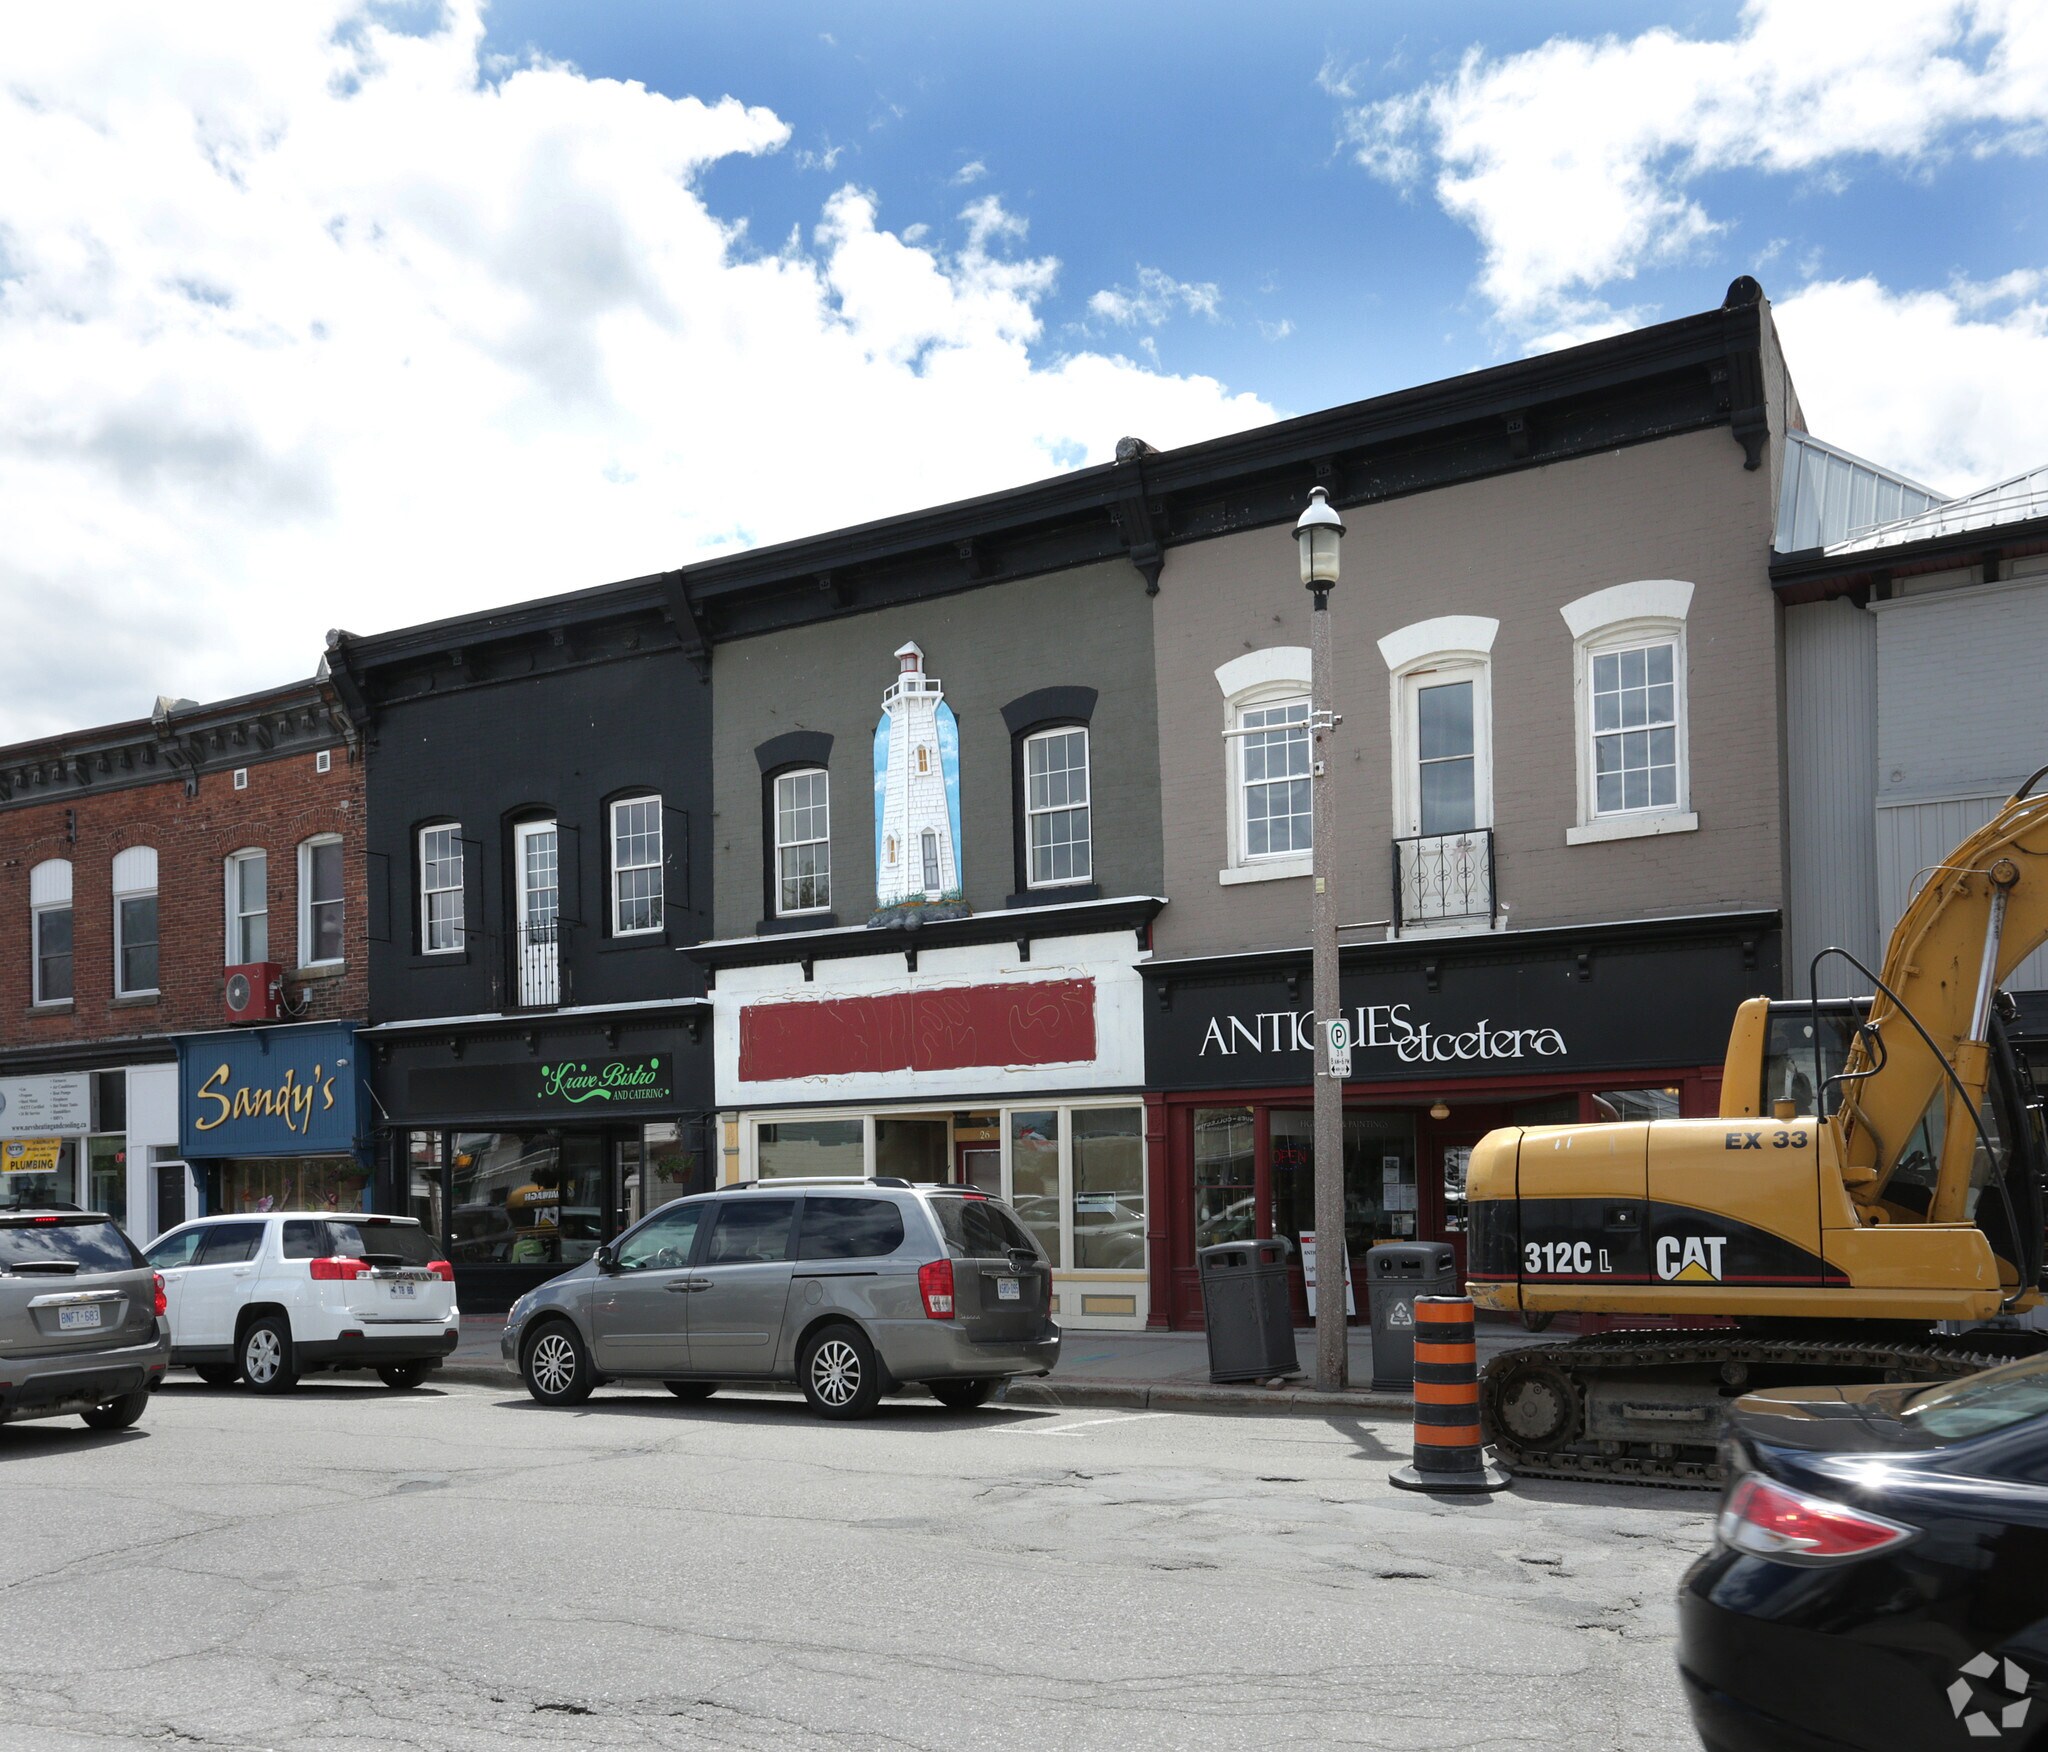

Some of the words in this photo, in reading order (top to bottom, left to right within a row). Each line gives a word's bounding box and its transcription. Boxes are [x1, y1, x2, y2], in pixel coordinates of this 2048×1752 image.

[1335, 1029, 1343, 1043] P
[1397, 1018, 1567, 1062] etcetera
[546, 1062, 600, 1098] Krave
[598, 1062, 656, 1087] Bistro
[195, 1063, 336, 1135] Sandy's
[613, 1089, 628, 1101] AND
[628, 1088, 664, 1100] CATERING
[980, 1130, 990, 1140] 26
[1725, 1132, 1762, 1150] EX
[1772, 1130, 1808, 1149] 33
[10, 1159, 54, 1170] PLUMBING
[1524, 1240, 1592, 1274] 312C
[1599, 1249, 1612, 1273] L
[1656, 1235, 1727, 1282] CAT
[84, 1311, 99, 1321] 683
